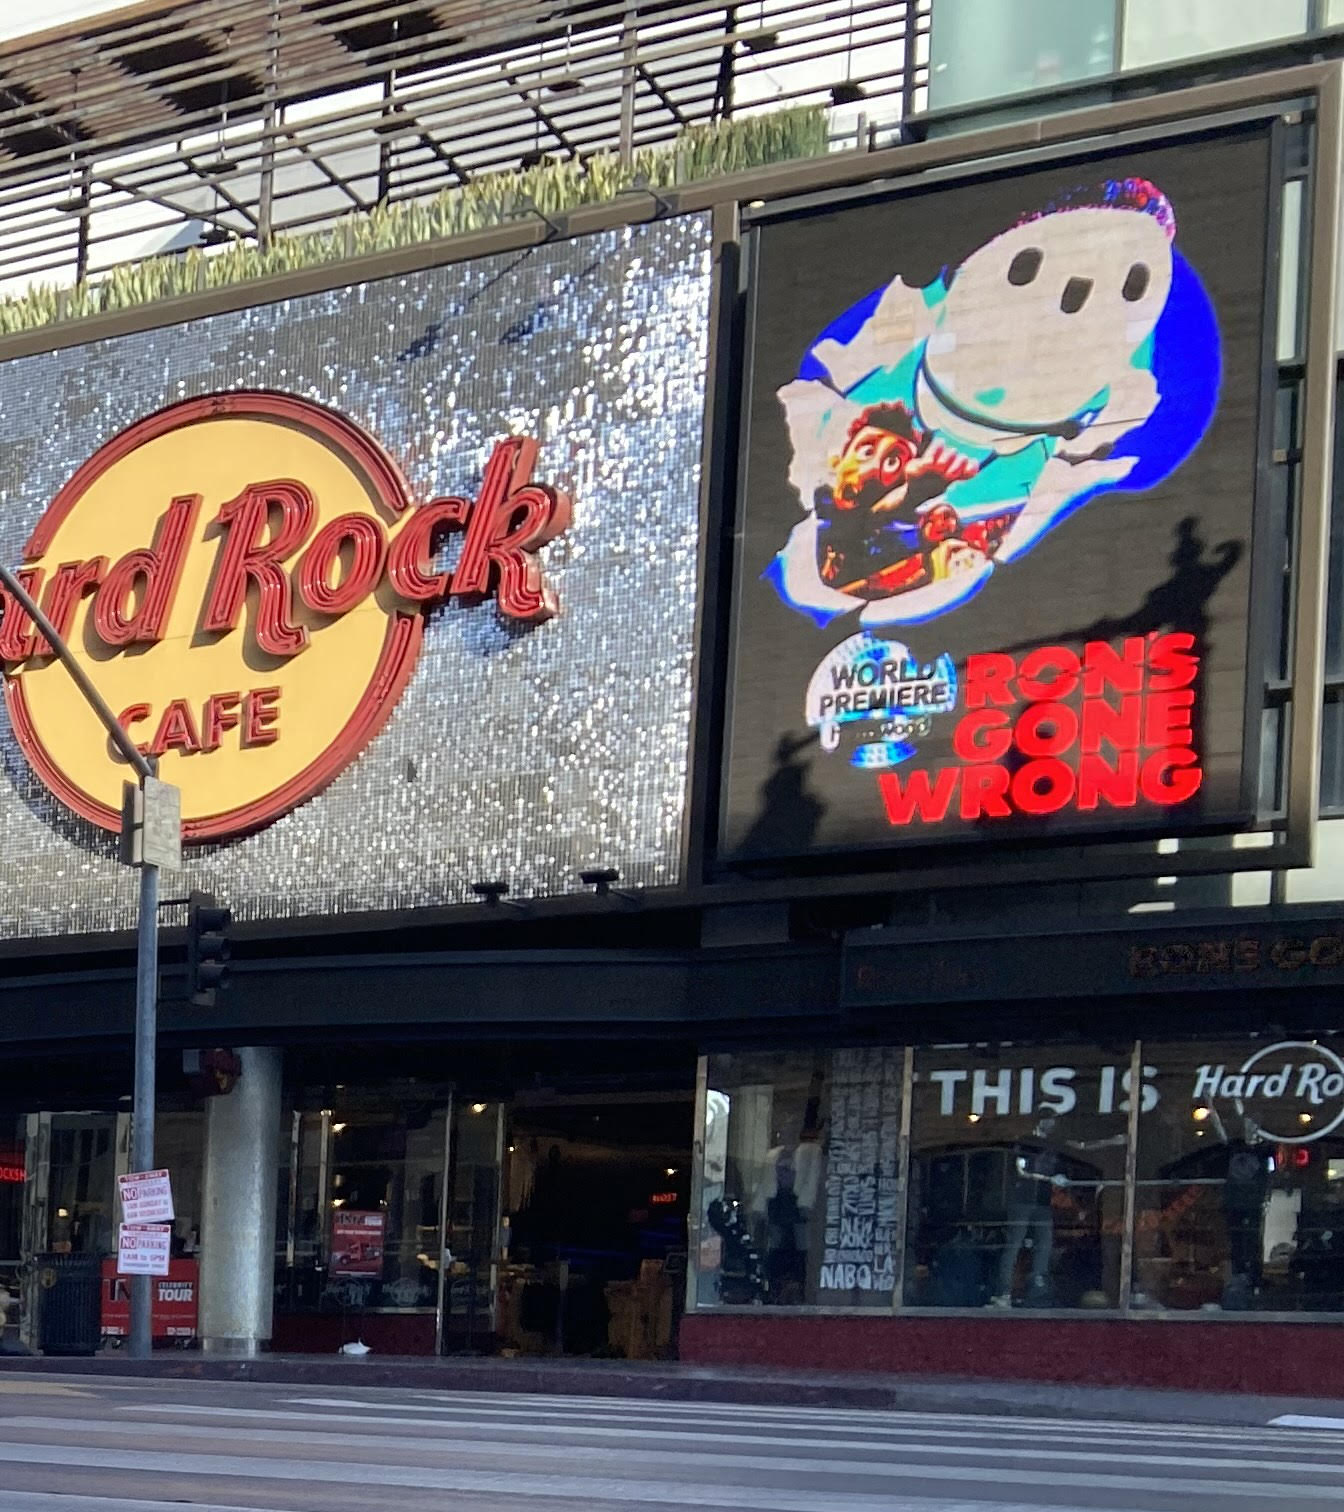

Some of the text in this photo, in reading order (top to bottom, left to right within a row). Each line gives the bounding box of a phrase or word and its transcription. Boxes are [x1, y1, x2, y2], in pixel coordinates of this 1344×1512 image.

[203, 436, 572, 657] Rock
[830, 659, 939, 690] WORLD
[965, 632, 1200, 709] RON'S
[116, 686, 281, 758] CAFE
[819, 682, 949, 718] PREMIERE
[952, 689, 1195, 763] GONE
[877, 746, 1203, 826] WRONG
[929, 1065, 1160, 1116] THIS IS
[1191, 1063, 1294, 1100] Hard
[123, 1188, 137, 1201] NO
[122, 1237, 167, 1249] NO PARKING
[157, 1288, 193, 1302] TOUR
